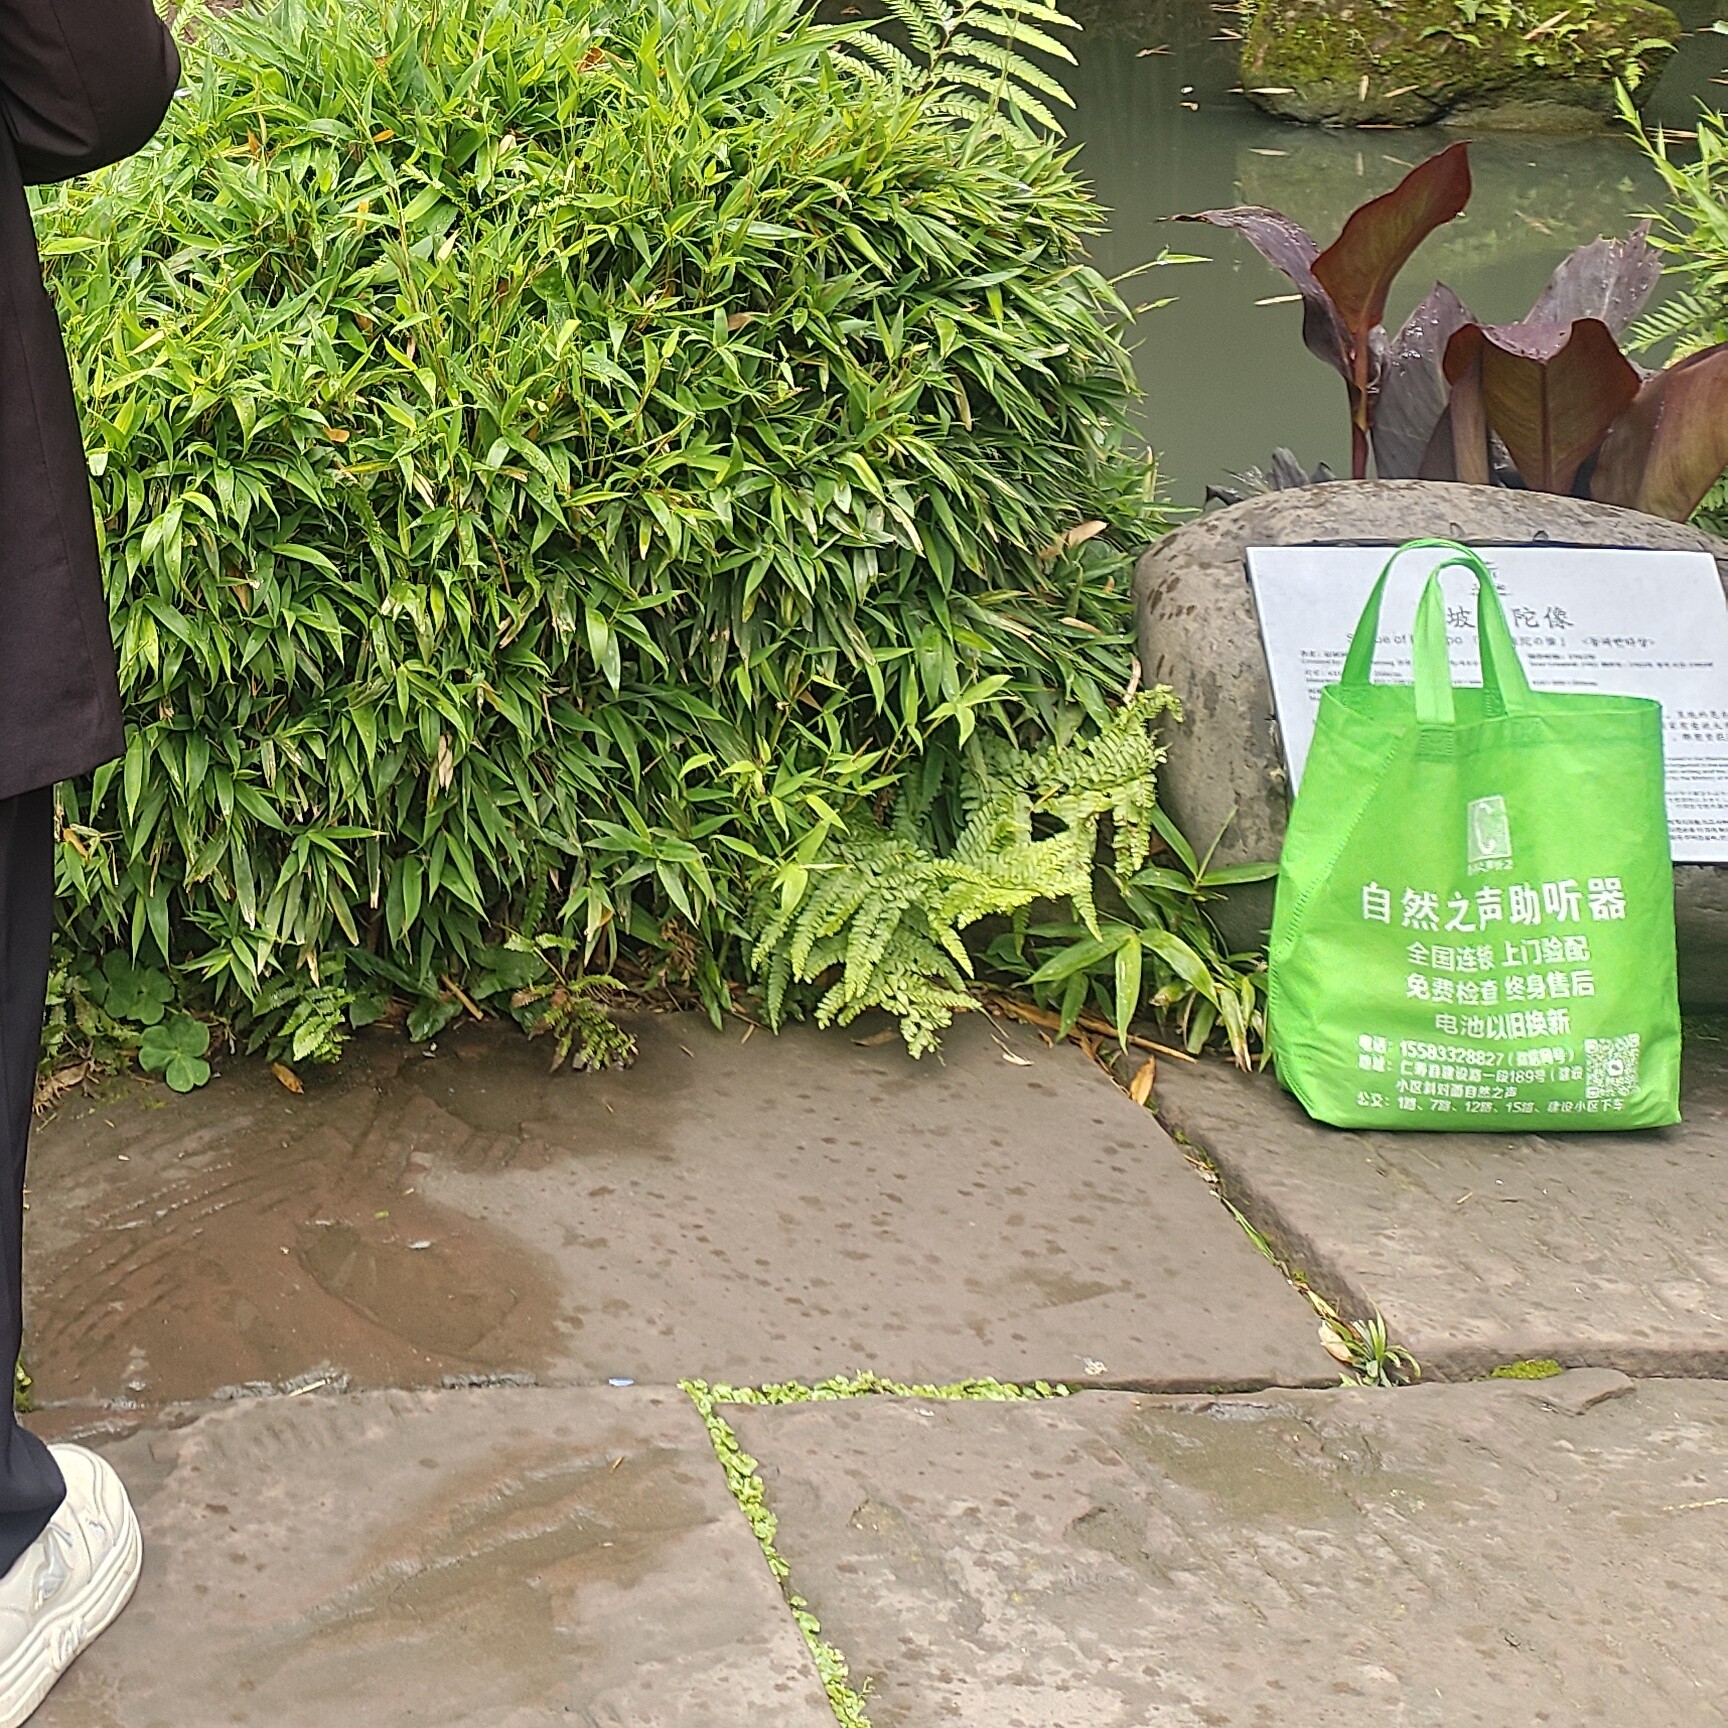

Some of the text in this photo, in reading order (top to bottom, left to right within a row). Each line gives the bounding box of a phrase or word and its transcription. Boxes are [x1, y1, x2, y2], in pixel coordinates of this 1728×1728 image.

[1361, 876, 1627, 933] 自然之声助听器
[1406, 935, 1591, 972] 全国连锁 上门验配
[1406, 969, 1595, 1006] 免费检查 终身售后
[1435, 1008, 1571, 1040] 电池以旧换新
